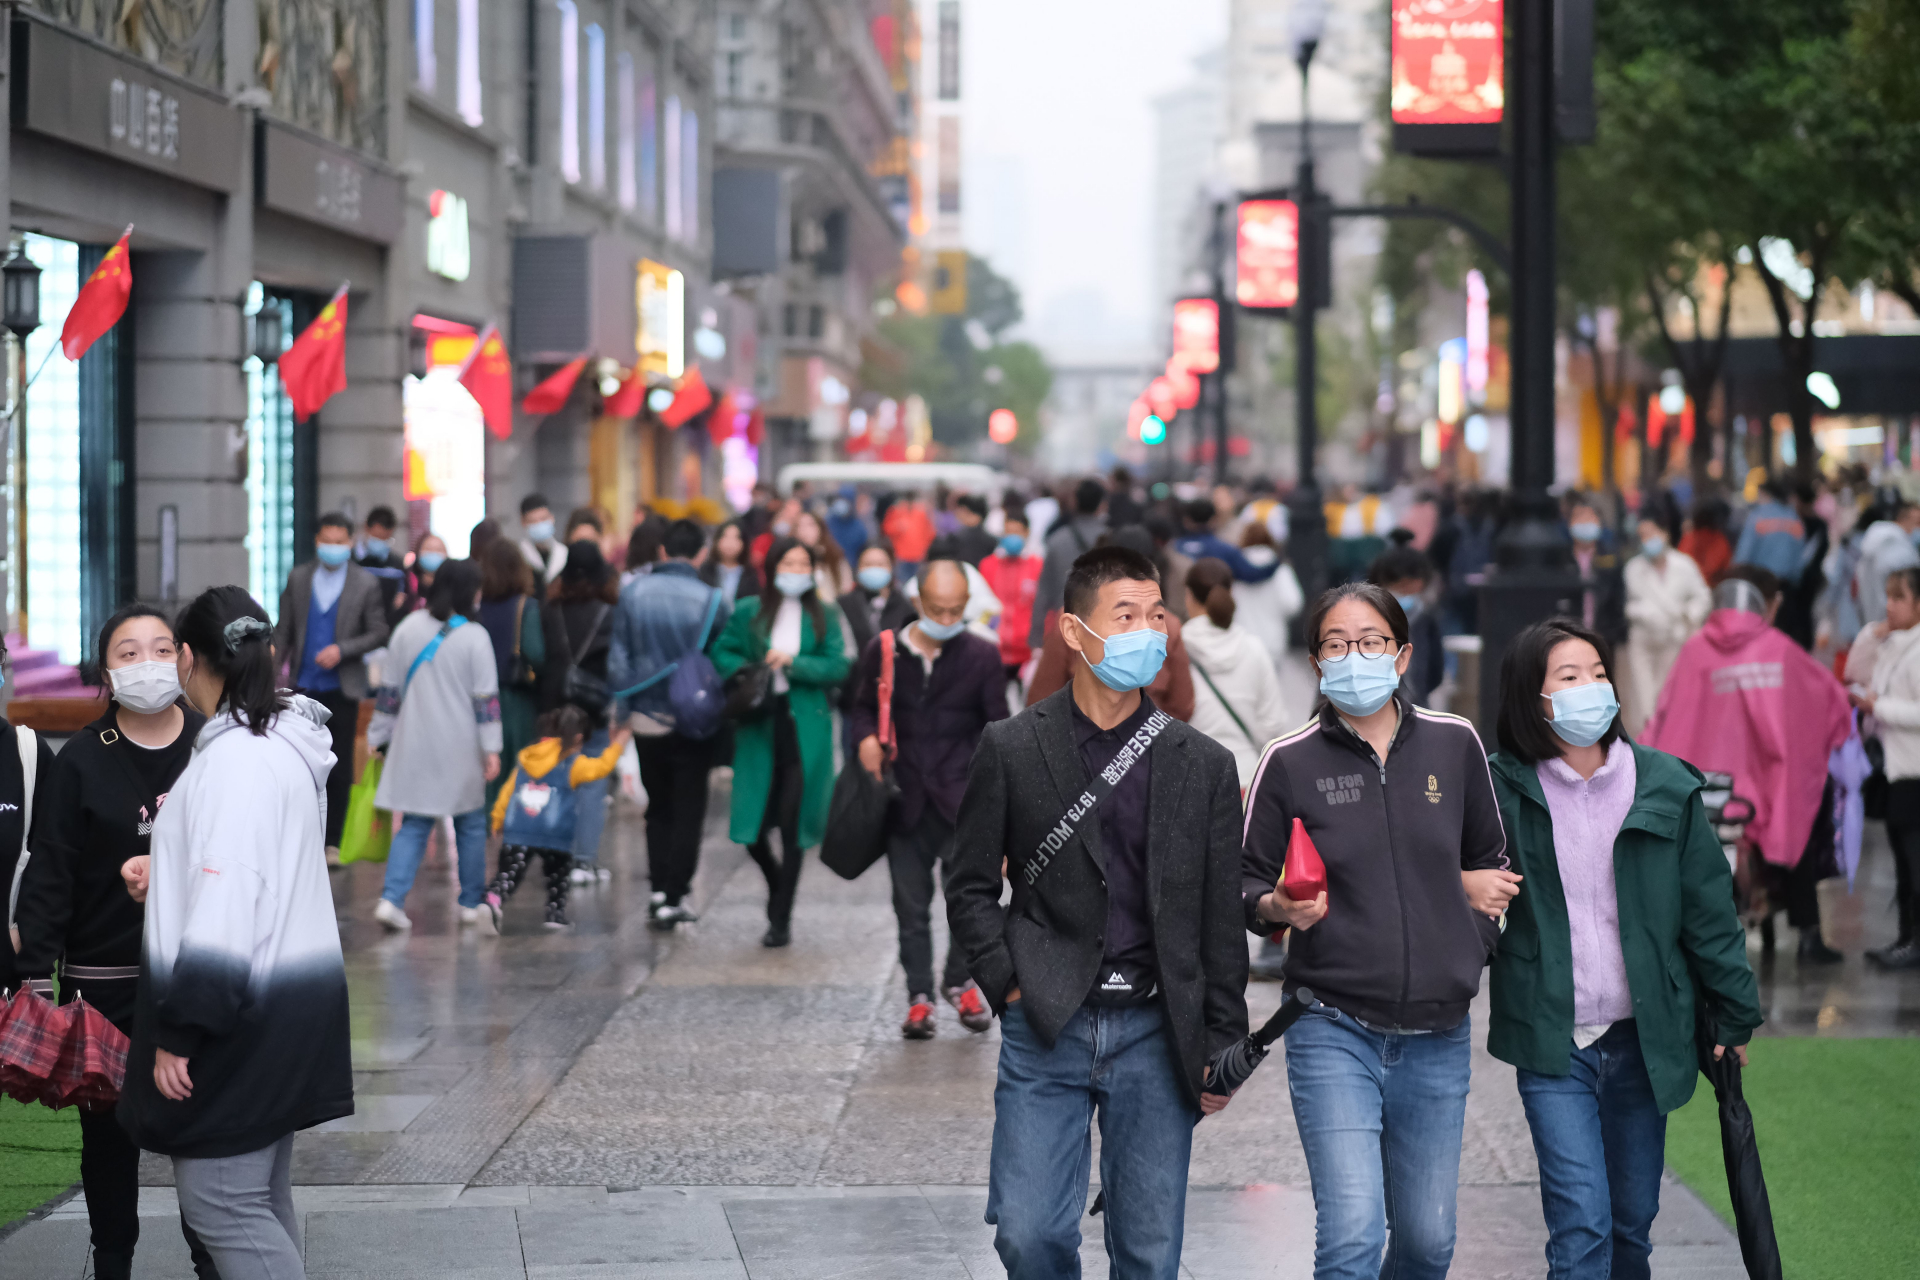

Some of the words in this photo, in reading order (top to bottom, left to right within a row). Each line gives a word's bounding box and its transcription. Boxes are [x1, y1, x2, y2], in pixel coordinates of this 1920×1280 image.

[1101, 745, 1133, 781] EDITION
[1108, 751, 1138, 786] LIMITED
[1316, 778, 1336, 792] GO
[1337, 773, 1365, 790] FOR
[1326, 788, 1361, 806] GOLD
